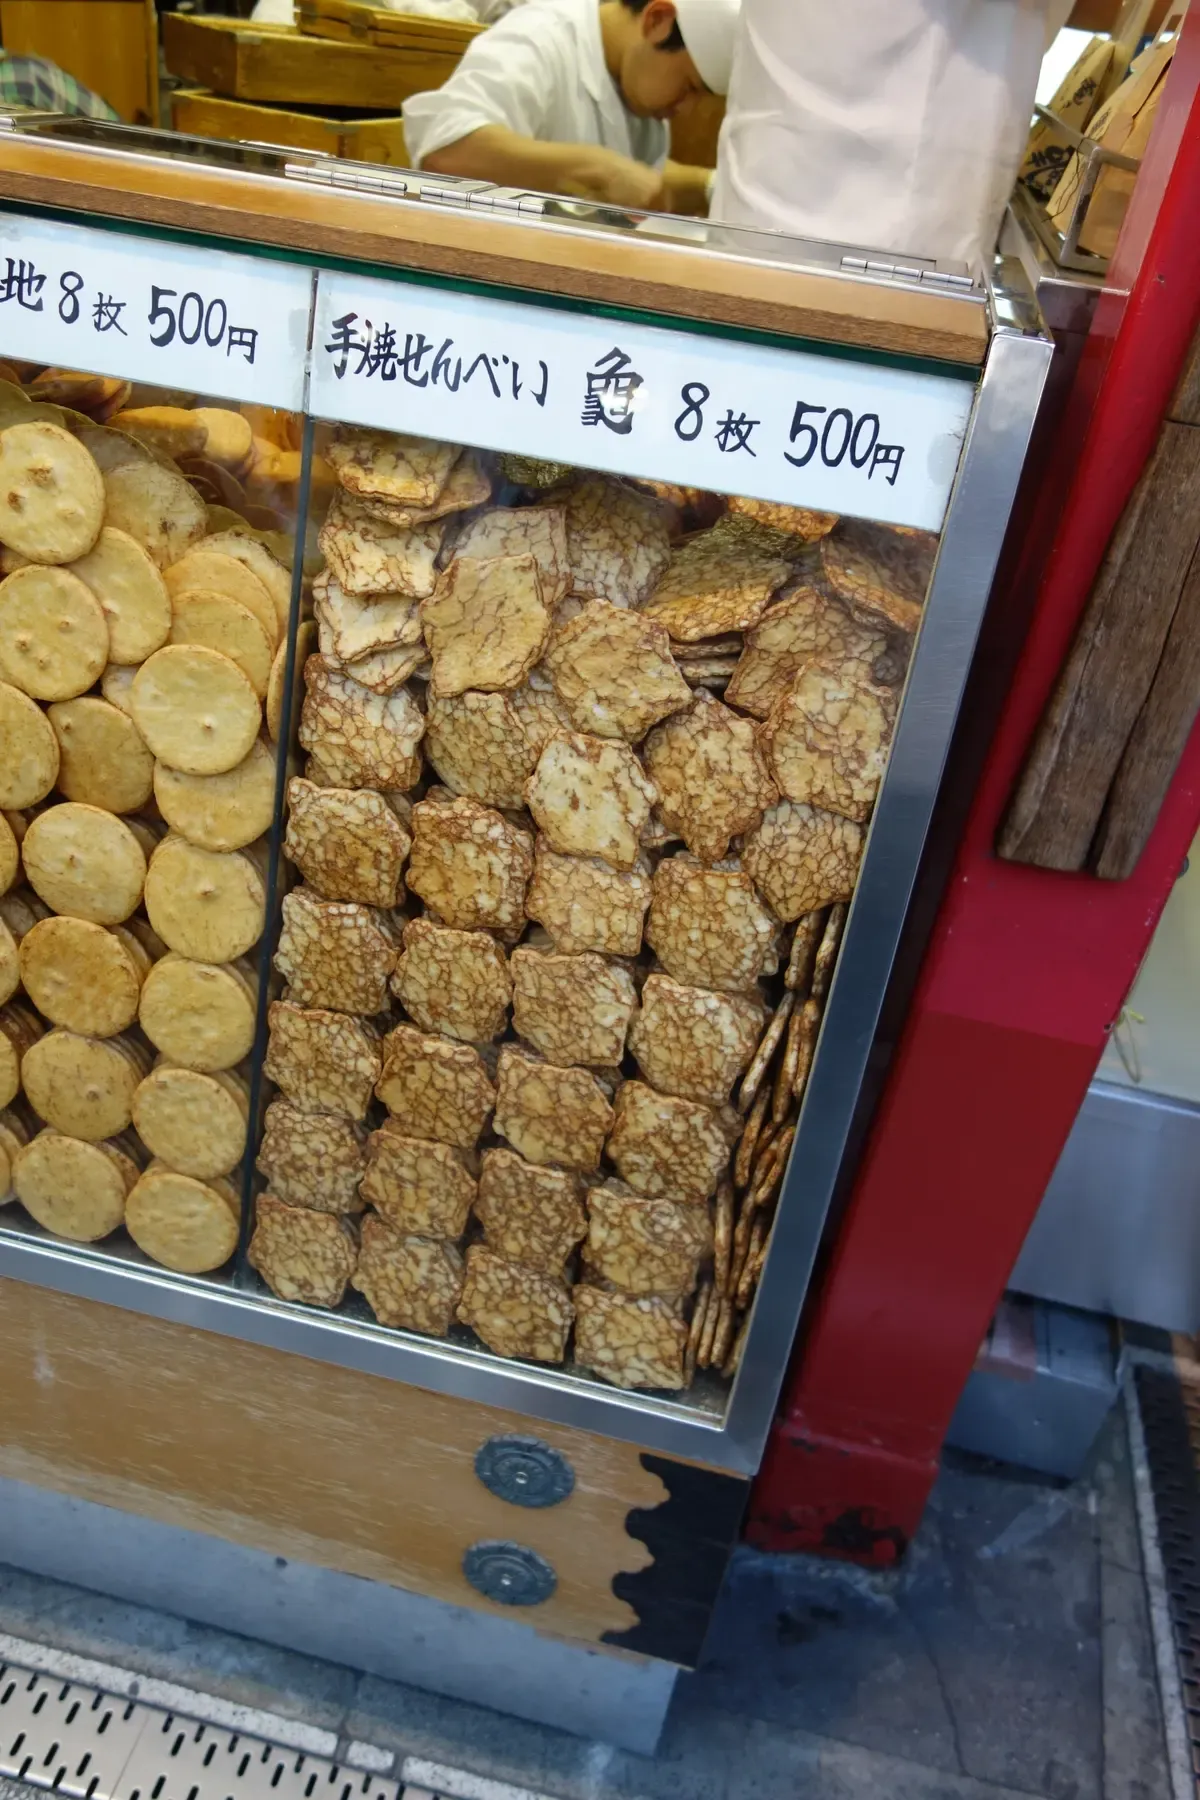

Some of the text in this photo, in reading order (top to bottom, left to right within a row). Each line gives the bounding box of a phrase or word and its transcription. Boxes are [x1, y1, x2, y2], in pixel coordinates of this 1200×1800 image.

[59, 271, 128, 336] 8枚
[148, 285, 258, 364] 500円
[325, 312, 548, 407] 手焼せんべい
[674, 382, 760, 457] 8枚
[784, 401, 905, 486] 500円
